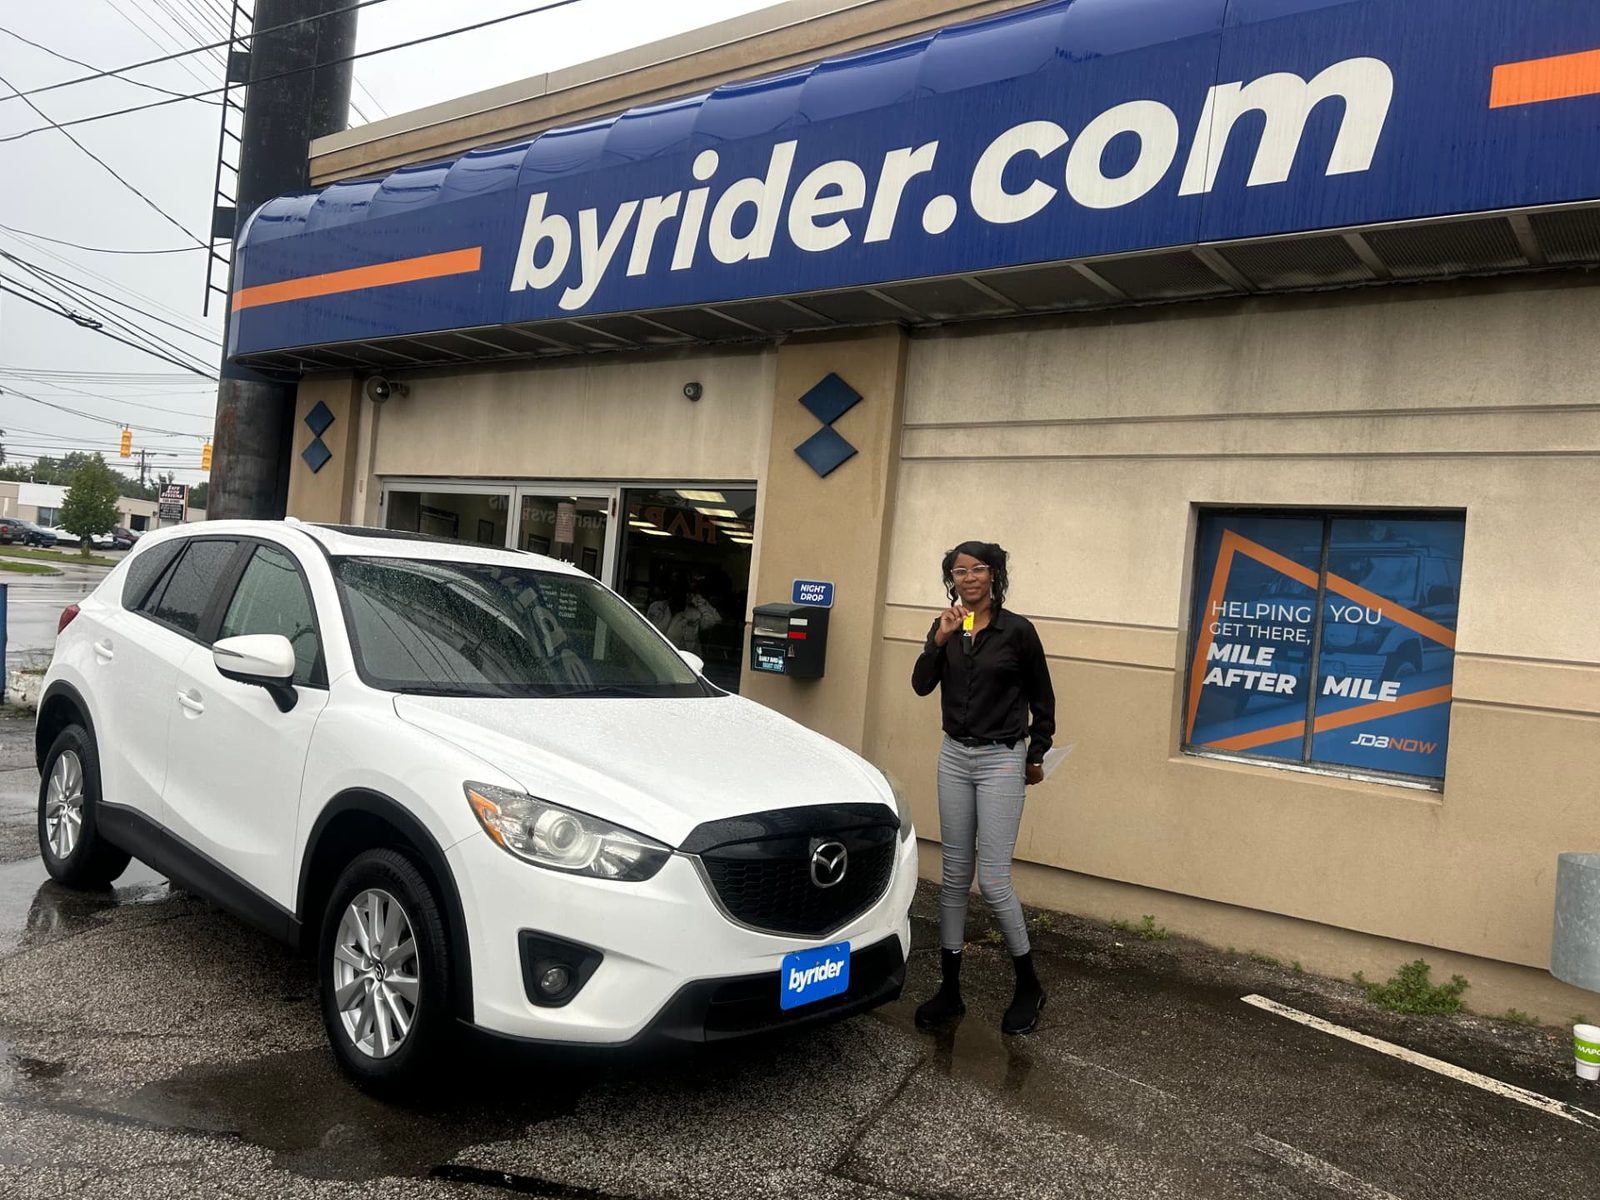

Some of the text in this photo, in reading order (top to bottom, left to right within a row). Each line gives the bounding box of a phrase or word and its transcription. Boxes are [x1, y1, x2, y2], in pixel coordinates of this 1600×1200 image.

[510, 57, 1394, 311] byrider.com
[800, 584, 826, 593] NIGHT
[800, 593, 824, 602] DROP
[1211, 600, 1383, 626] HELPING YOU
[1209, 622, 1311, 645] GET THERE,
[1206, 642, 1275, 667] MILE
[1202, 667, 1400, 702] AFTER MILE
[788, 958, 845, 993] byrider
